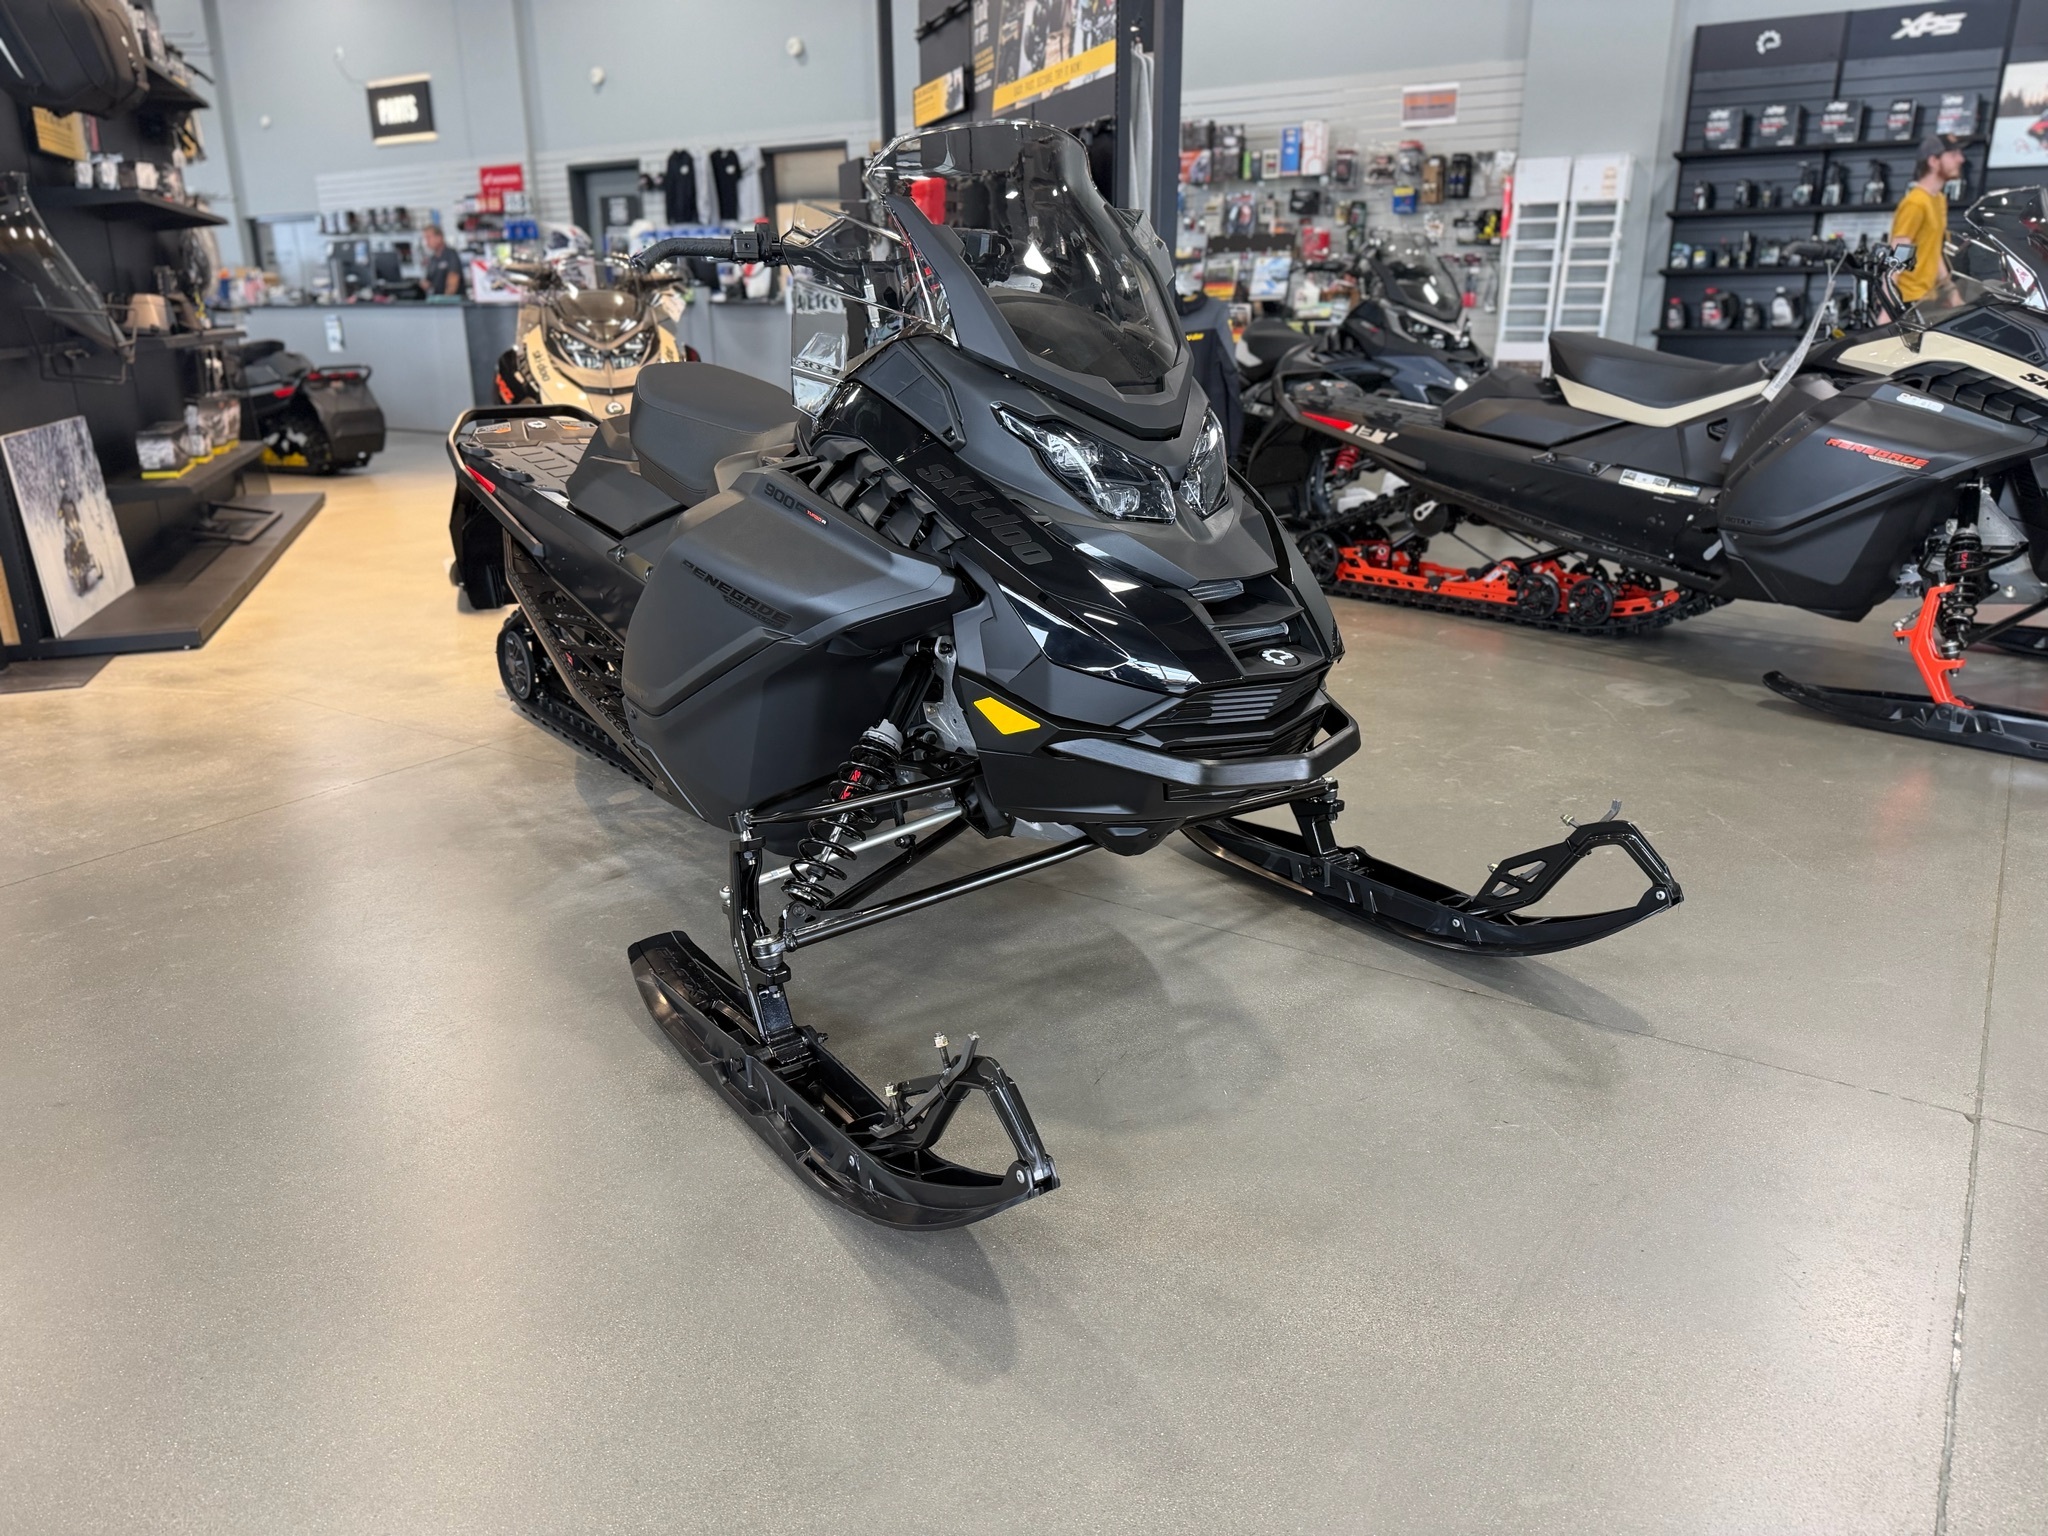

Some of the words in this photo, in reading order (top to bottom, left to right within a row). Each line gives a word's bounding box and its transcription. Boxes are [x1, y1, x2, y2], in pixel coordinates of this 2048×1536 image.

[1891, 11, 1967, 40] XPS
[1826, 437, 1930, 468] RENEGADE
[764, 482, 796, 511] 900
[682, 559, 794, 625] RENEGADE
